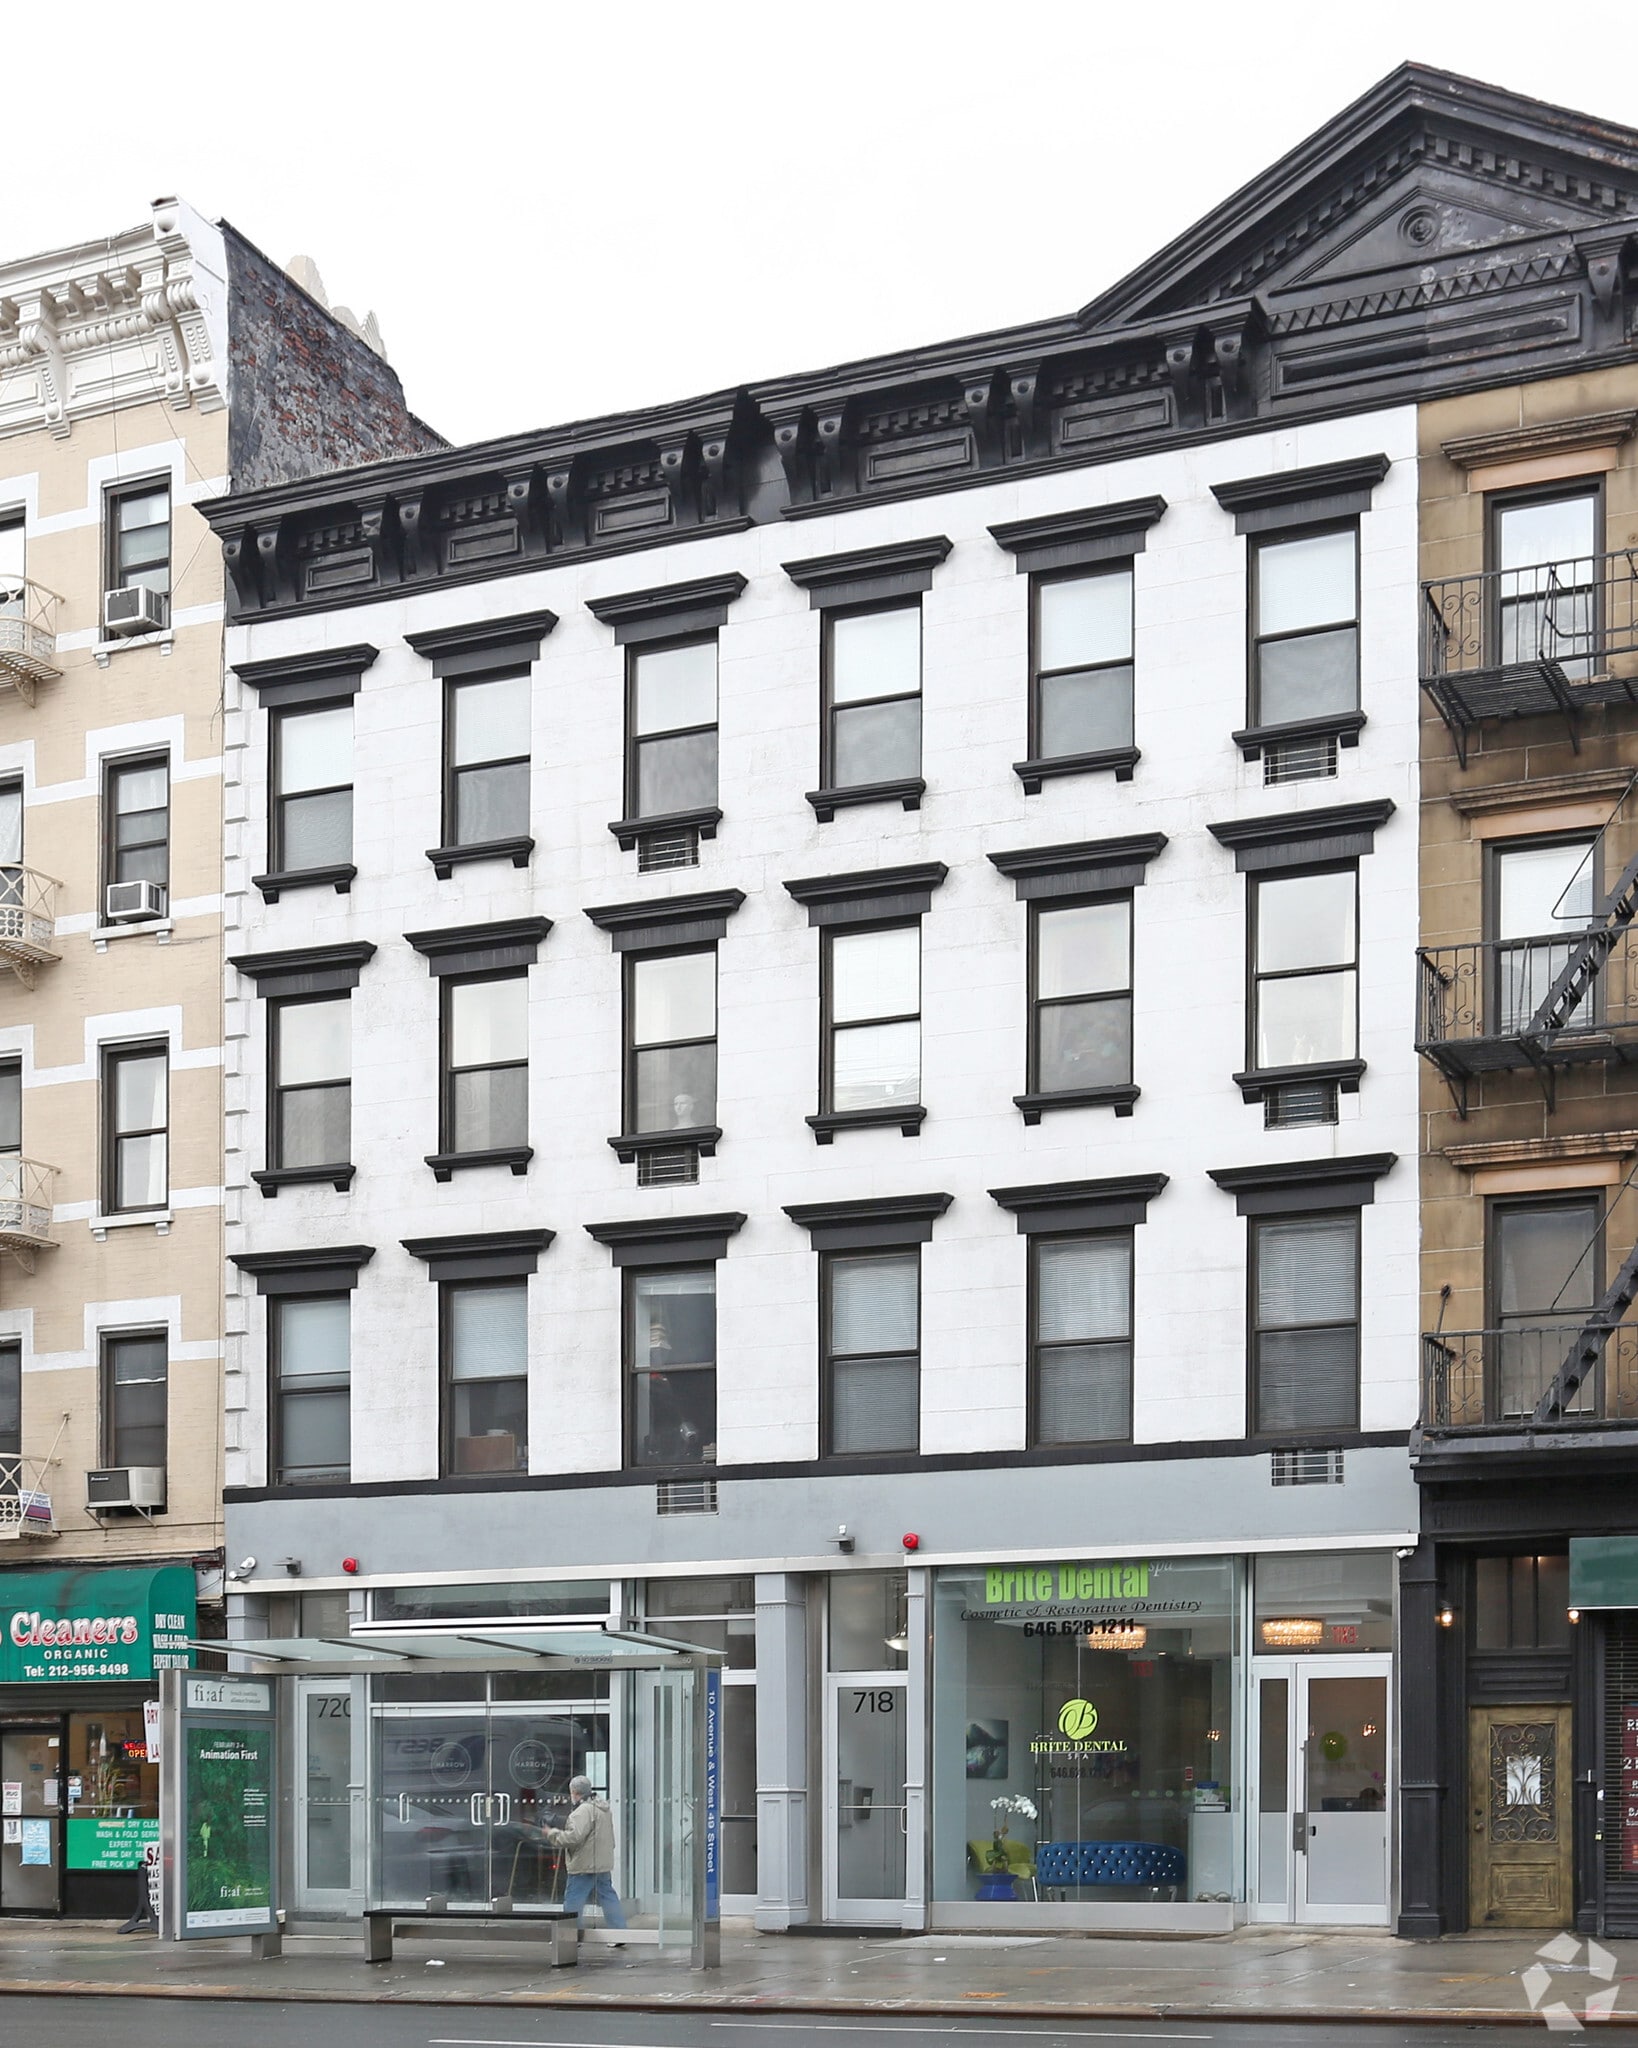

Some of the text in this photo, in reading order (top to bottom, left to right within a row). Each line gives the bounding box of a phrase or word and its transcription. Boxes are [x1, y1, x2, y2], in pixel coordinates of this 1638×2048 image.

[986, 1560, 1174, 1604] Brite Dental spa
[960, 1608, 1022, 1621] Cosmetic
[1046, 1602, 1127, 1618] Restorative
[1131, 1599, 1203, 1614] Dentistry
[10, 1611, 139, 1647] Cleaners
[155, 1614, 186, 1629] DRY CLEAN
[1023, 1617, 1136, 1638] 646.628.1211
[44, 1649, 109, 1660] ORGANIC
[24, 1664, 129, 1677] Tel: 212-956-8498
[708, 1690, 716, 1704] 10
[853, 1691, 894, 1713] 718
[707, 1708, 716, 1758] Avenue
[128, 1750, 148, 1758] OPE
[199, 1749, 258, 1760] Animation First
[1030, 1740, 1128, 1753] BRITE DENTAL
[707, 1774, 716, 1809] West
[127, 1821, 140, 1829] DRY
[706, 1832, 715, 1874] Street
